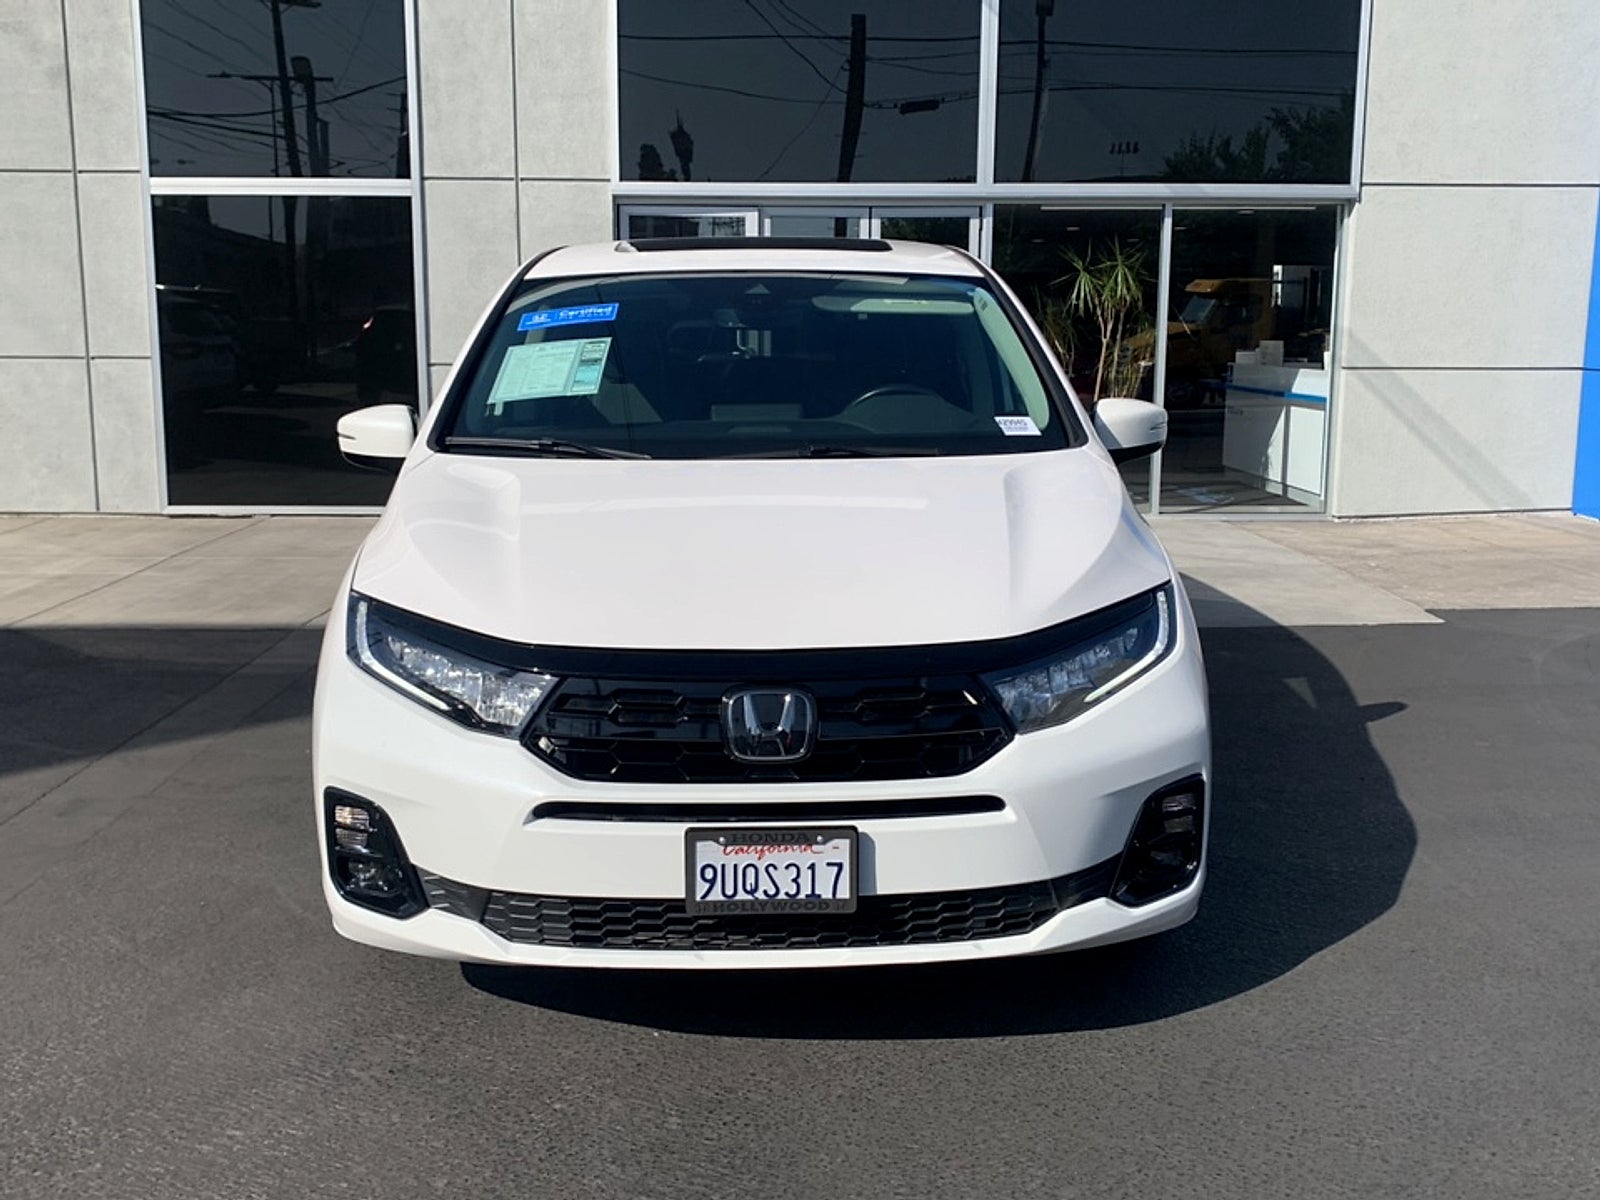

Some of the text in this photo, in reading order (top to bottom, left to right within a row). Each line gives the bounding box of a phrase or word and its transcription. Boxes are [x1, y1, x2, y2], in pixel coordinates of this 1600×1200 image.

[560, 306, 612, 317] Certified
[728, 833, 810, 844] HONDA
[700, 862, 844, 900] 9UQS317
[713, 901, 831, 912] HOLLYWOOD
